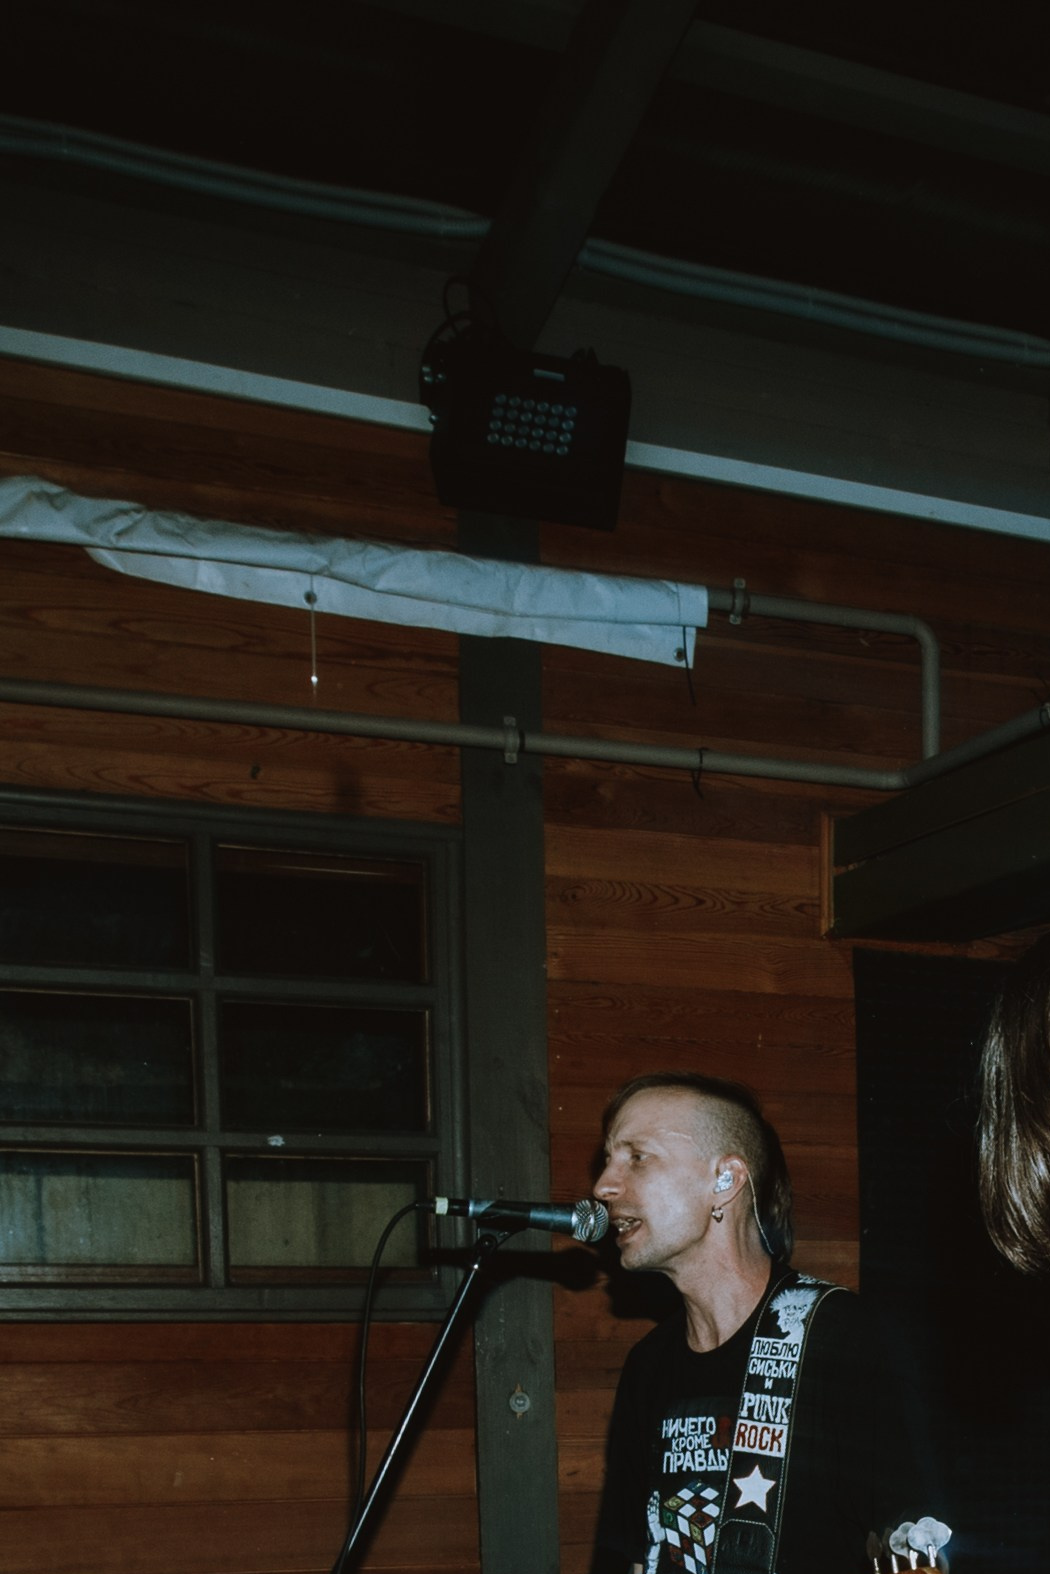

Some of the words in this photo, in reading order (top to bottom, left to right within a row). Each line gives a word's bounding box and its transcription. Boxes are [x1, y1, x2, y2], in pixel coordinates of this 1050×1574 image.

[751, 1339, 799, 1358] ЛЮБЛЮ
[748, 1358, 798, 1379] СИСЬКИ
[740, 1391, 792, 1424] PUNK
[661, 1416, 717, 1439] НИЧЕГО
[735, 1422, 784, 1452] ROCK
[671, 1433, 712, 1453] КРОМЕ
[662, 1448, 730, 1474] ПРАВДЫ
